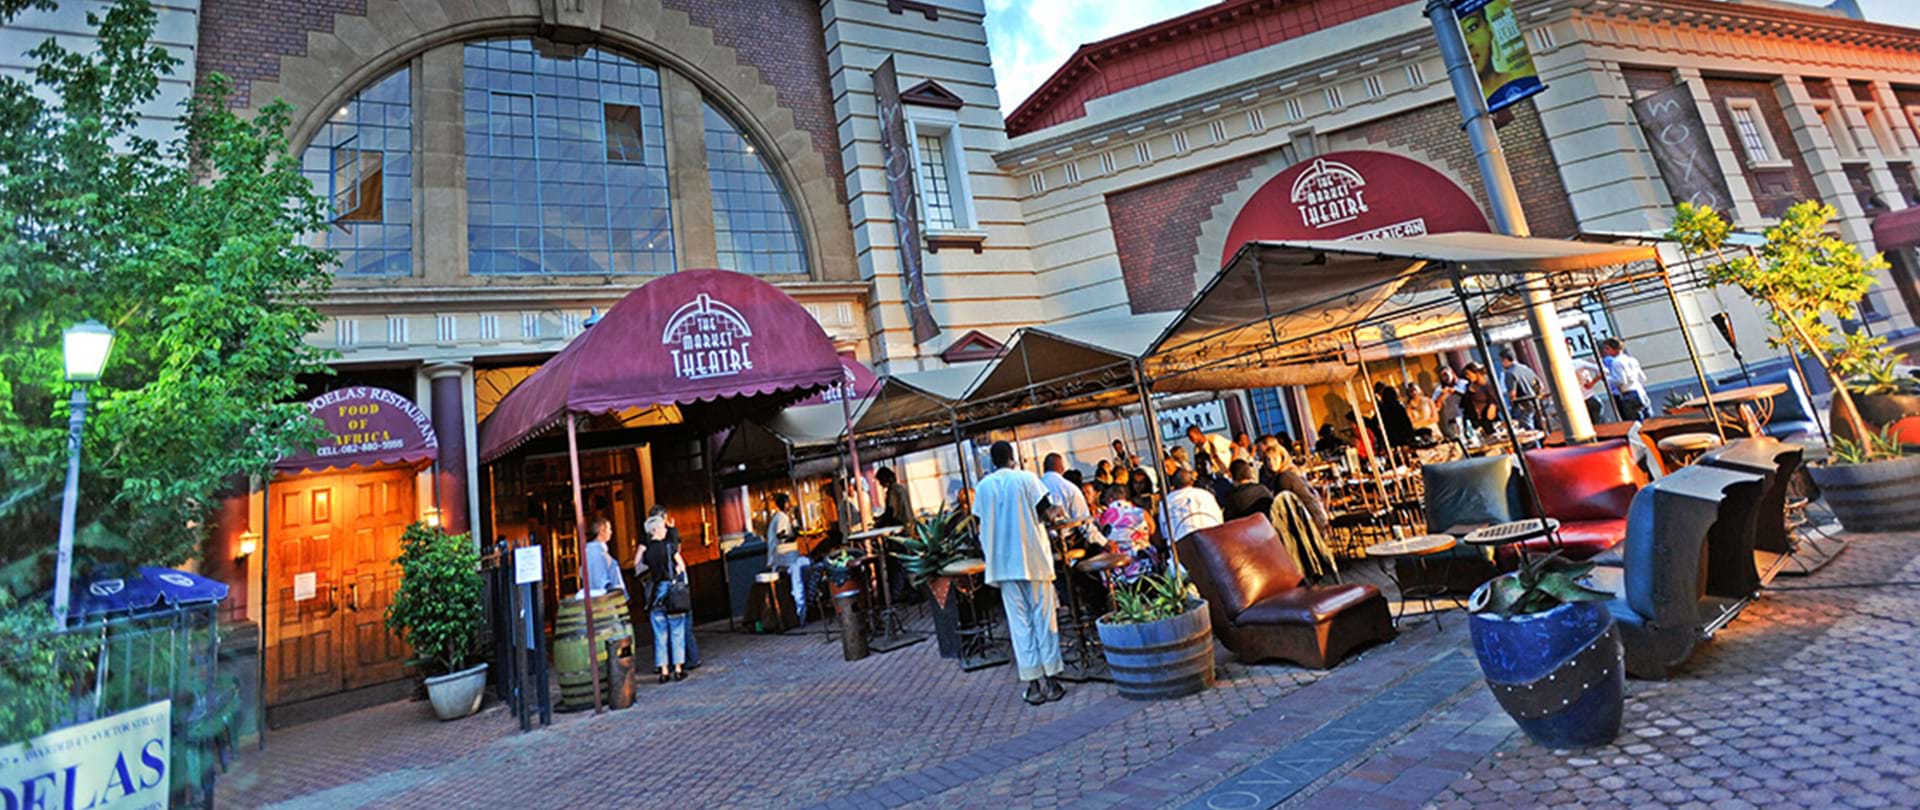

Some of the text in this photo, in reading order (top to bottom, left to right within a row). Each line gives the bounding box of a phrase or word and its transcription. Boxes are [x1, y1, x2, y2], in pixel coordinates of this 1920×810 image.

[1316, 175, 1334, 189] THE
[1307, 184, 1350, 205] MARKET
[1297, 190, 1369, 228] THEATRE
[696, 316, 717, 333] THE
[682, 330, 734, 351] MARKET
[670, 341, 754, 379] THEATRE
[338, 403, 380, 418] FOOD
[369, 387, 440, 449] RESTAURANT
[348, 419, 368, 431] OF
[336, 430, 391, 446] AFRICA
